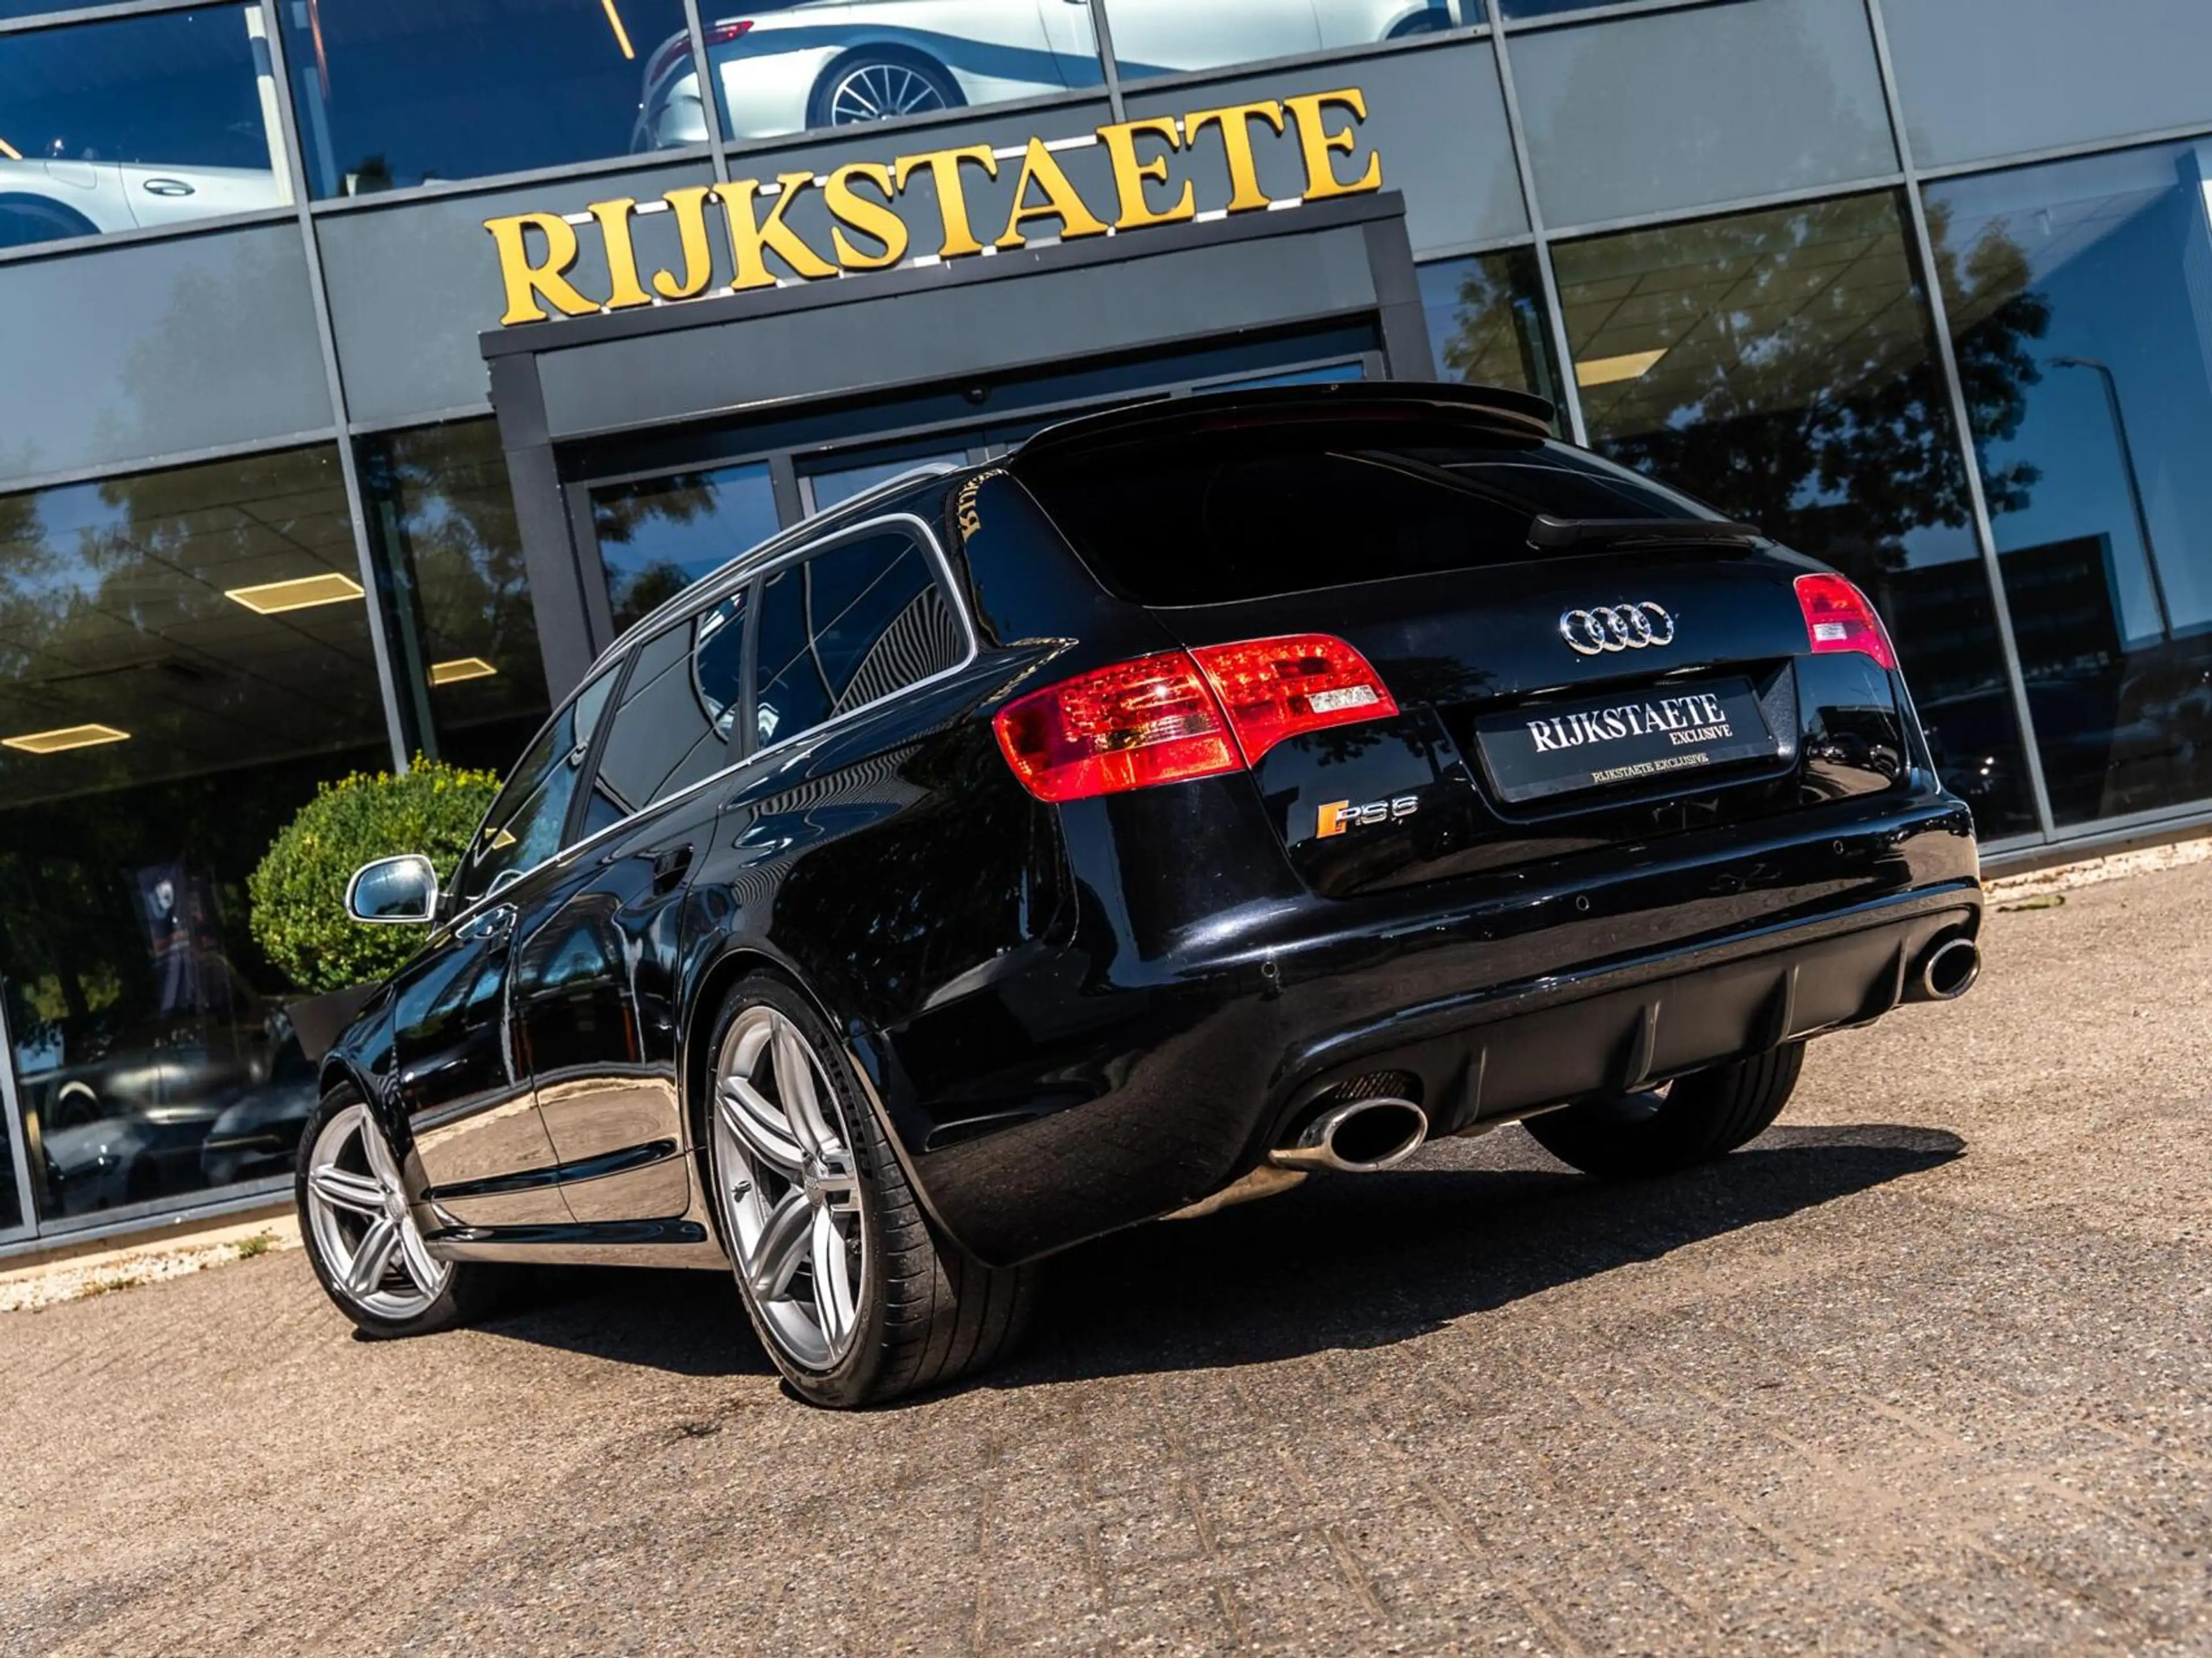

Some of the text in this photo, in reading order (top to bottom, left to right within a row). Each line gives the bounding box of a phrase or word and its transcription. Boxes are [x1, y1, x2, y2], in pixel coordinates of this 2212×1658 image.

[485, 88, 1382, 326] RIJKSTAETE
[1526, 693, 1727, 752] RIJKSTAETE
[1669, 723, 1733, 745] EXCLUSIVE
[1590, 752, 1709, 784] RIJKSTAETE EXCLUSIVE
